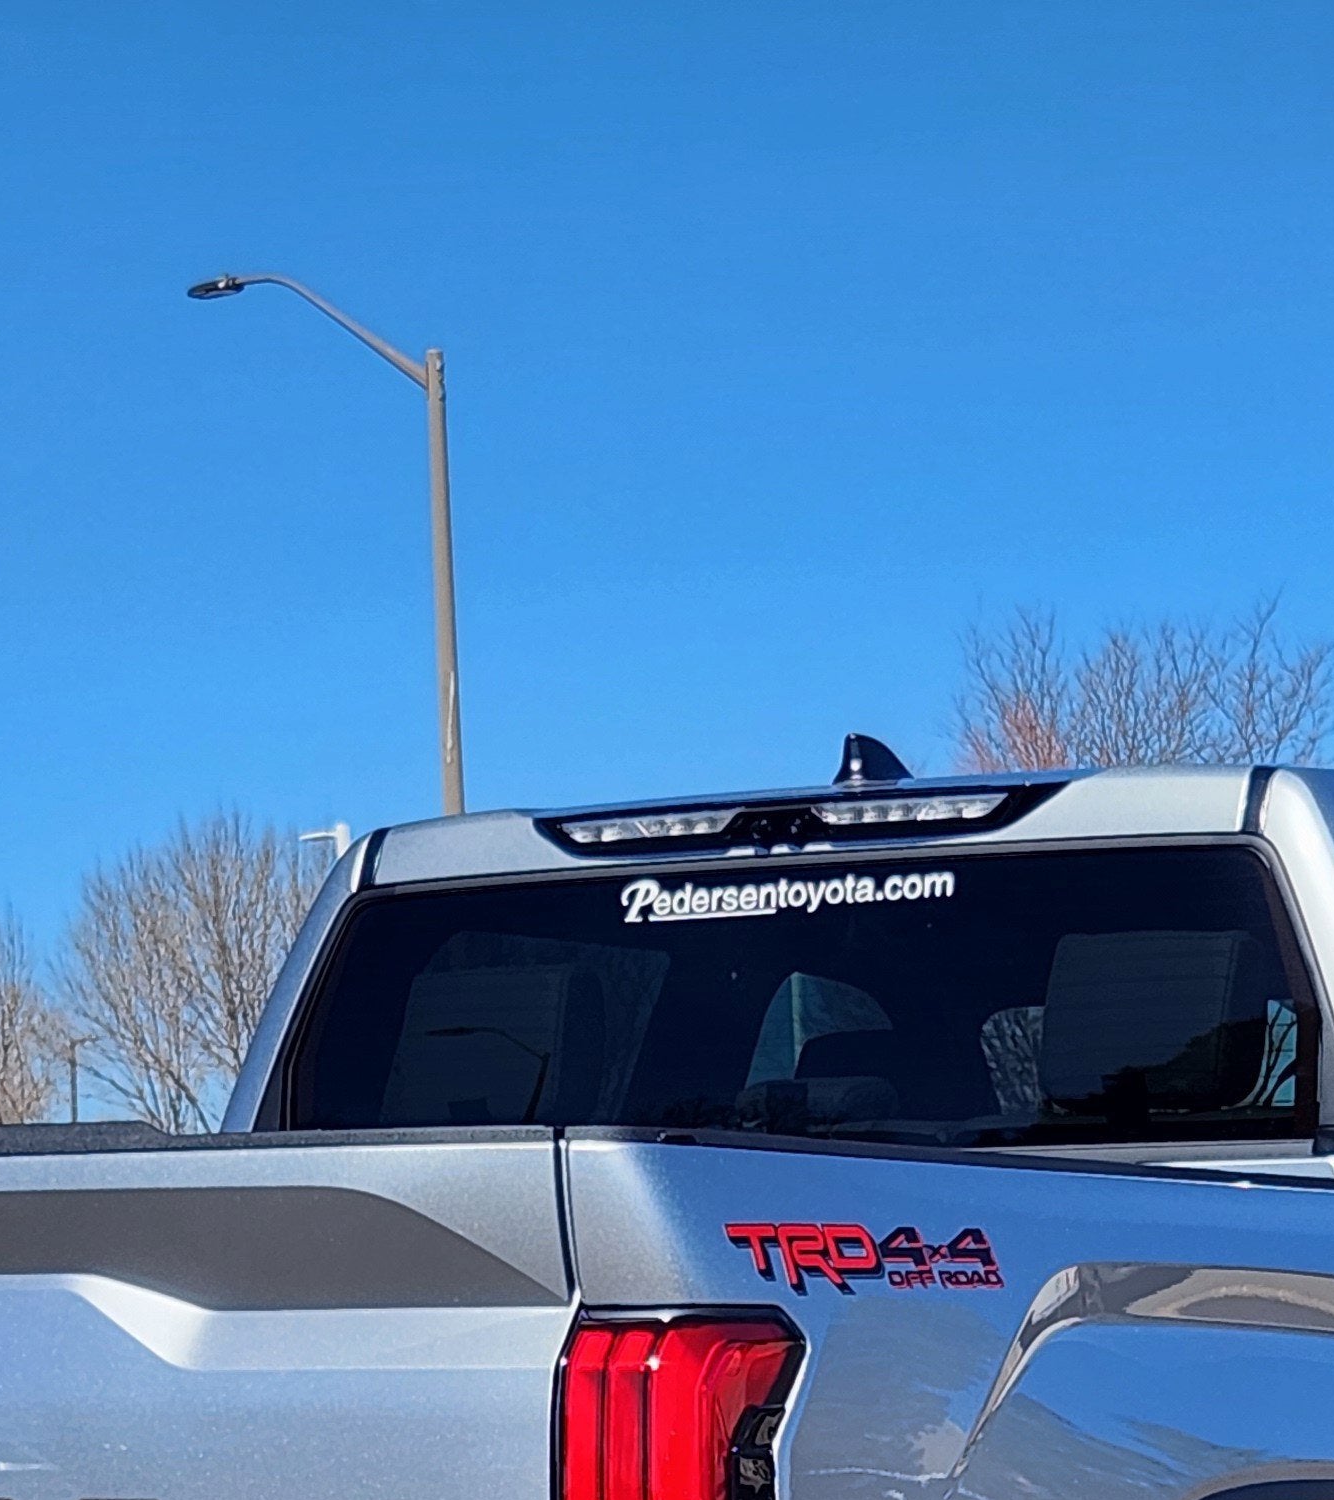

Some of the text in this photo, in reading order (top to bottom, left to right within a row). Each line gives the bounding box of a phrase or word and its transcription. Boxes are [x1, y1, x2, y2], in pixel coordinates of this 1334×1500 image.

[621, 872, 955, 923] Pedersentoyota.com
[724, 1223, 885, 1296] TRD
[887, 1270, 1005, 1290] OFF ROAD
